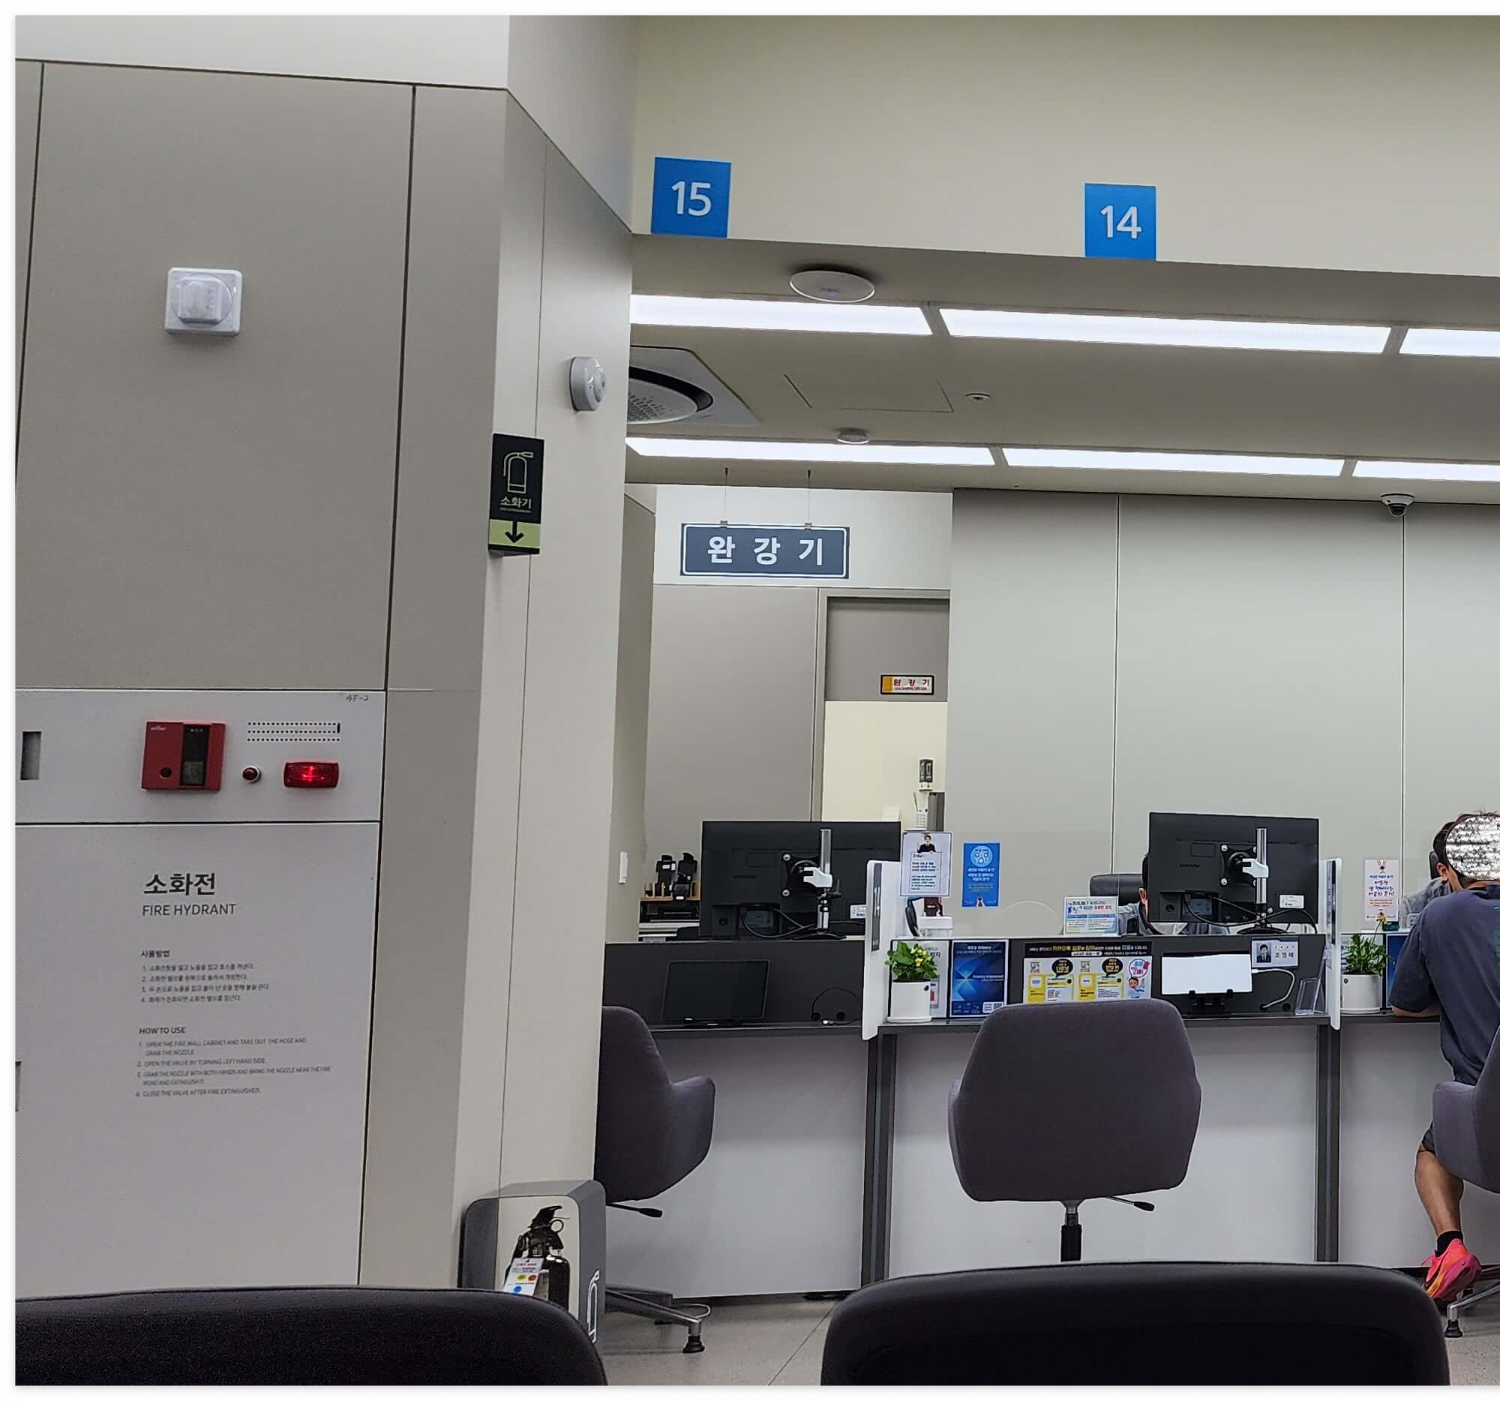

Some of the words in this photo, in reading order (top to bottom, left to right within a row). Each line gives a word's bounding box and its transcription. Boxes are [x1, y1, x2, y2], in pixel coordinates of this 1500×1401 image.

[672, 182, 712, 217] 15
[1101, 206, 1142, 239] 14
[500, 496, 532, 510] 소화기
[144, 873, 216, 896] 소화전
[142, 905, 170, 916] FIRE
[173, 903, 237, 915] HYDRANT
[140, 950, 170, 958] 사용방법
